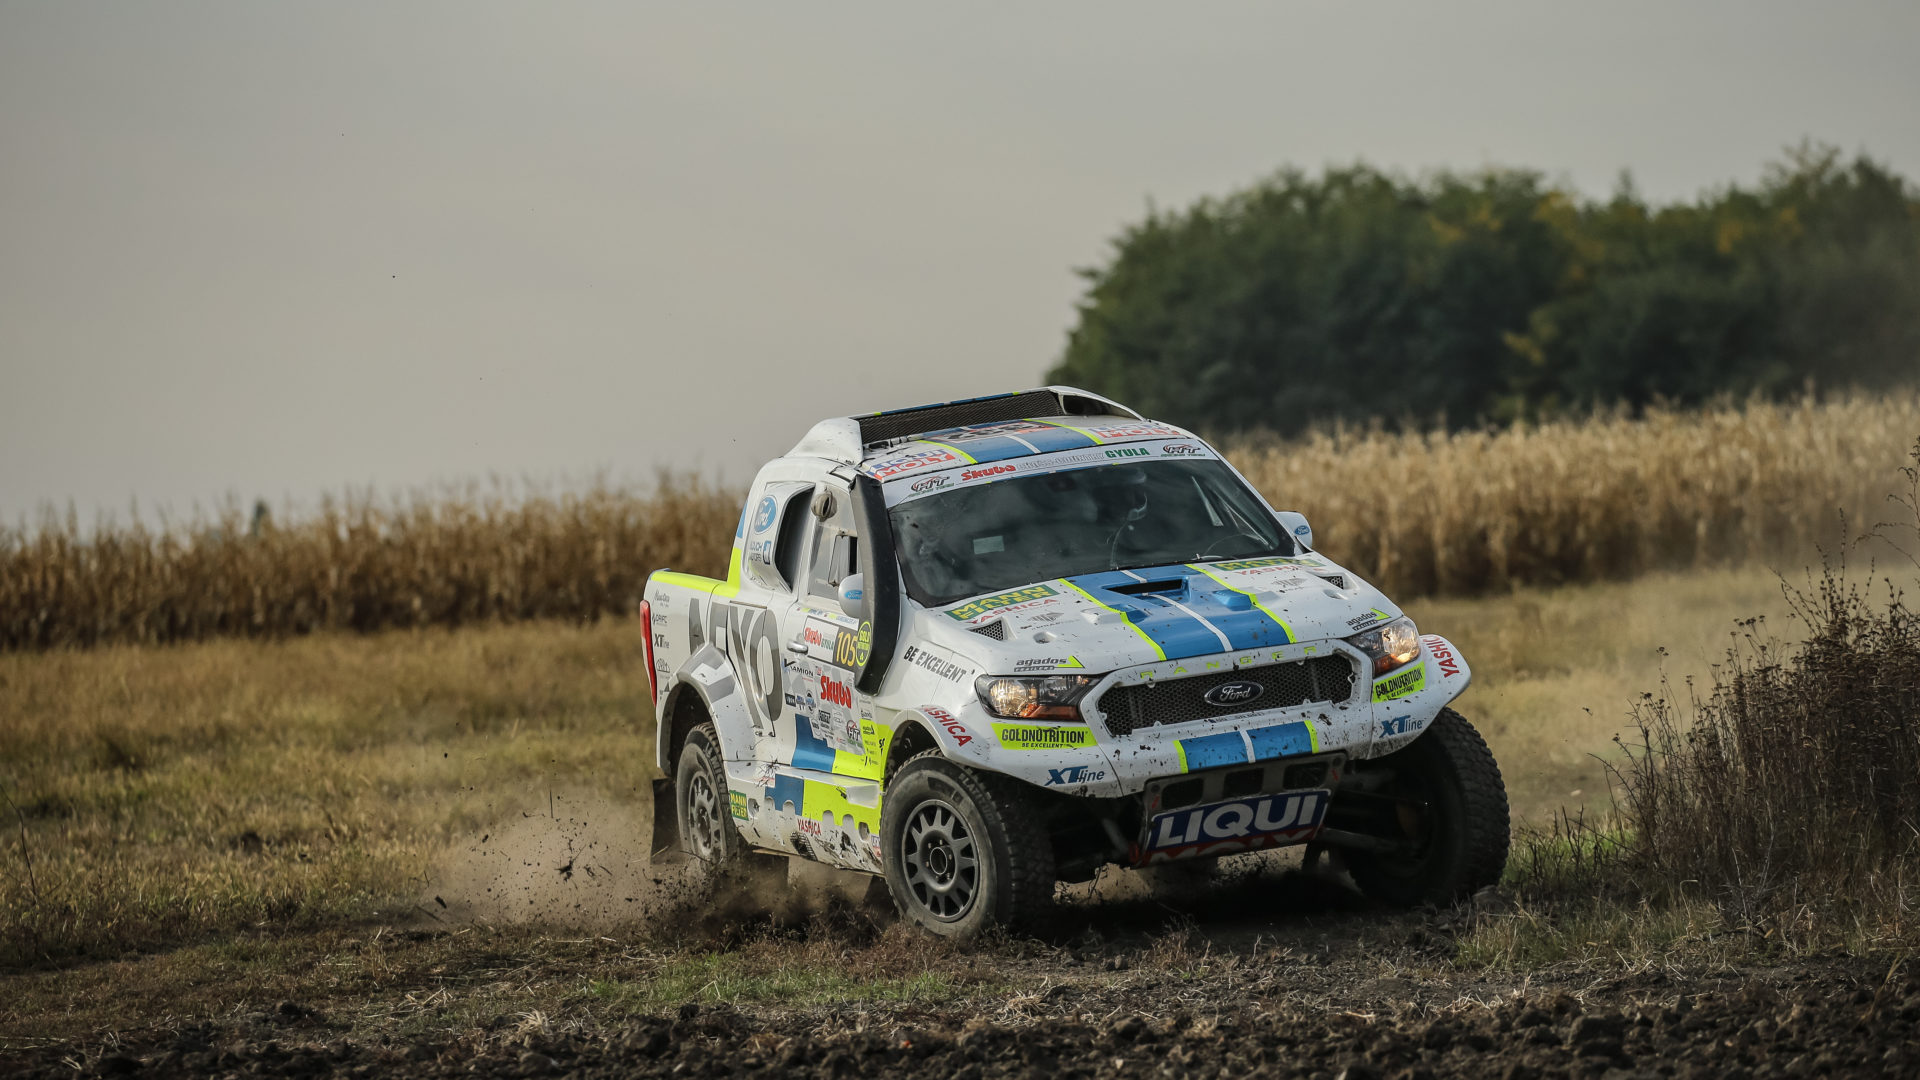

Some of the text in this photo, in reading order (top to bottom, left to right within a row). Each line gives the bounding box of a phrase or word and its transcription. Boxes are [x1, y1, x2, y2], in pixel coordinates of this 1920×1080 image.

[877, 453, 956, 478] MOLY
[960, 465, 1016, 482] Skuba
[1105, 447, 1151, 459] GYULA
[1233, 565, 1326, 576] YASHIA
[951, 586, 1046, 615] MANN
[964, 598, 1057, 624] YASHICA
[1345, 611, 1377, 626] agados
[836, 631, 858, 667] 105
[903, 645, 968, 684] BE EXCELLENT
[1016, 657, 1068, 667] agados
[1139, 645, 1318, 680] RANGER
[820, 674, 853, 710] Skuba
[1219, 685, 1251, 701] Ford
[1375, 668, 1423, 699] GOLDNUTRITION
[921, 705, 973, 748] ASHICA
[1001, 728, 1085, 744] GOLDNUTRITION
[1379, 715, 1423, 738] XTline
[1044, 765, 1105, 787] XTline
[729, 792, 747, 805] MANN
[797, 818, 822, 836] YASHICA
[1155, 794, 1320, 848] LIQUI
